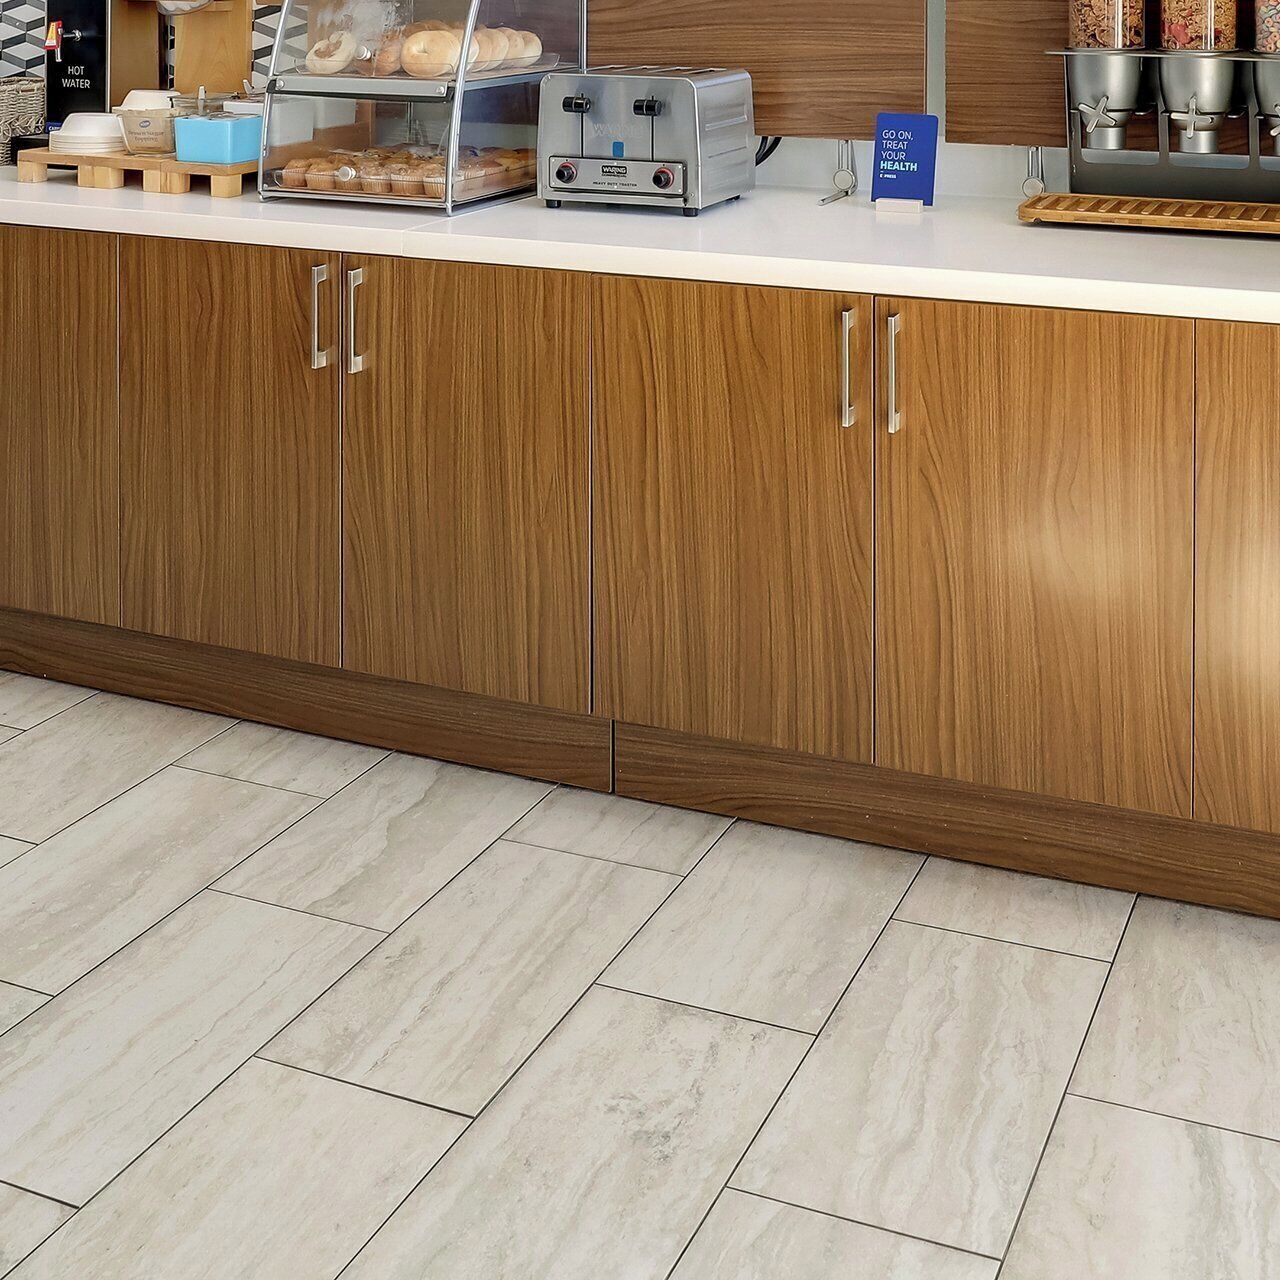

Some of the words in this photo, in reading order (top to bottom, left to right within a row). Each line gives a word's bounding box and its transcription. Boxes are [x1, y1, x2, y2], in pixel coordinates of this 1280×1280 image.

[67, 65, 85, 76] HOT
[61, 78, 91, 89] WATER
[882, 129, 896, 139] GO
[897, 130, 914, 140] ON,
[882, 140, 908, 150] TREAT
[881, 150, 906, 160] YOUR
[880, 160, 918, 172] HEALTH
